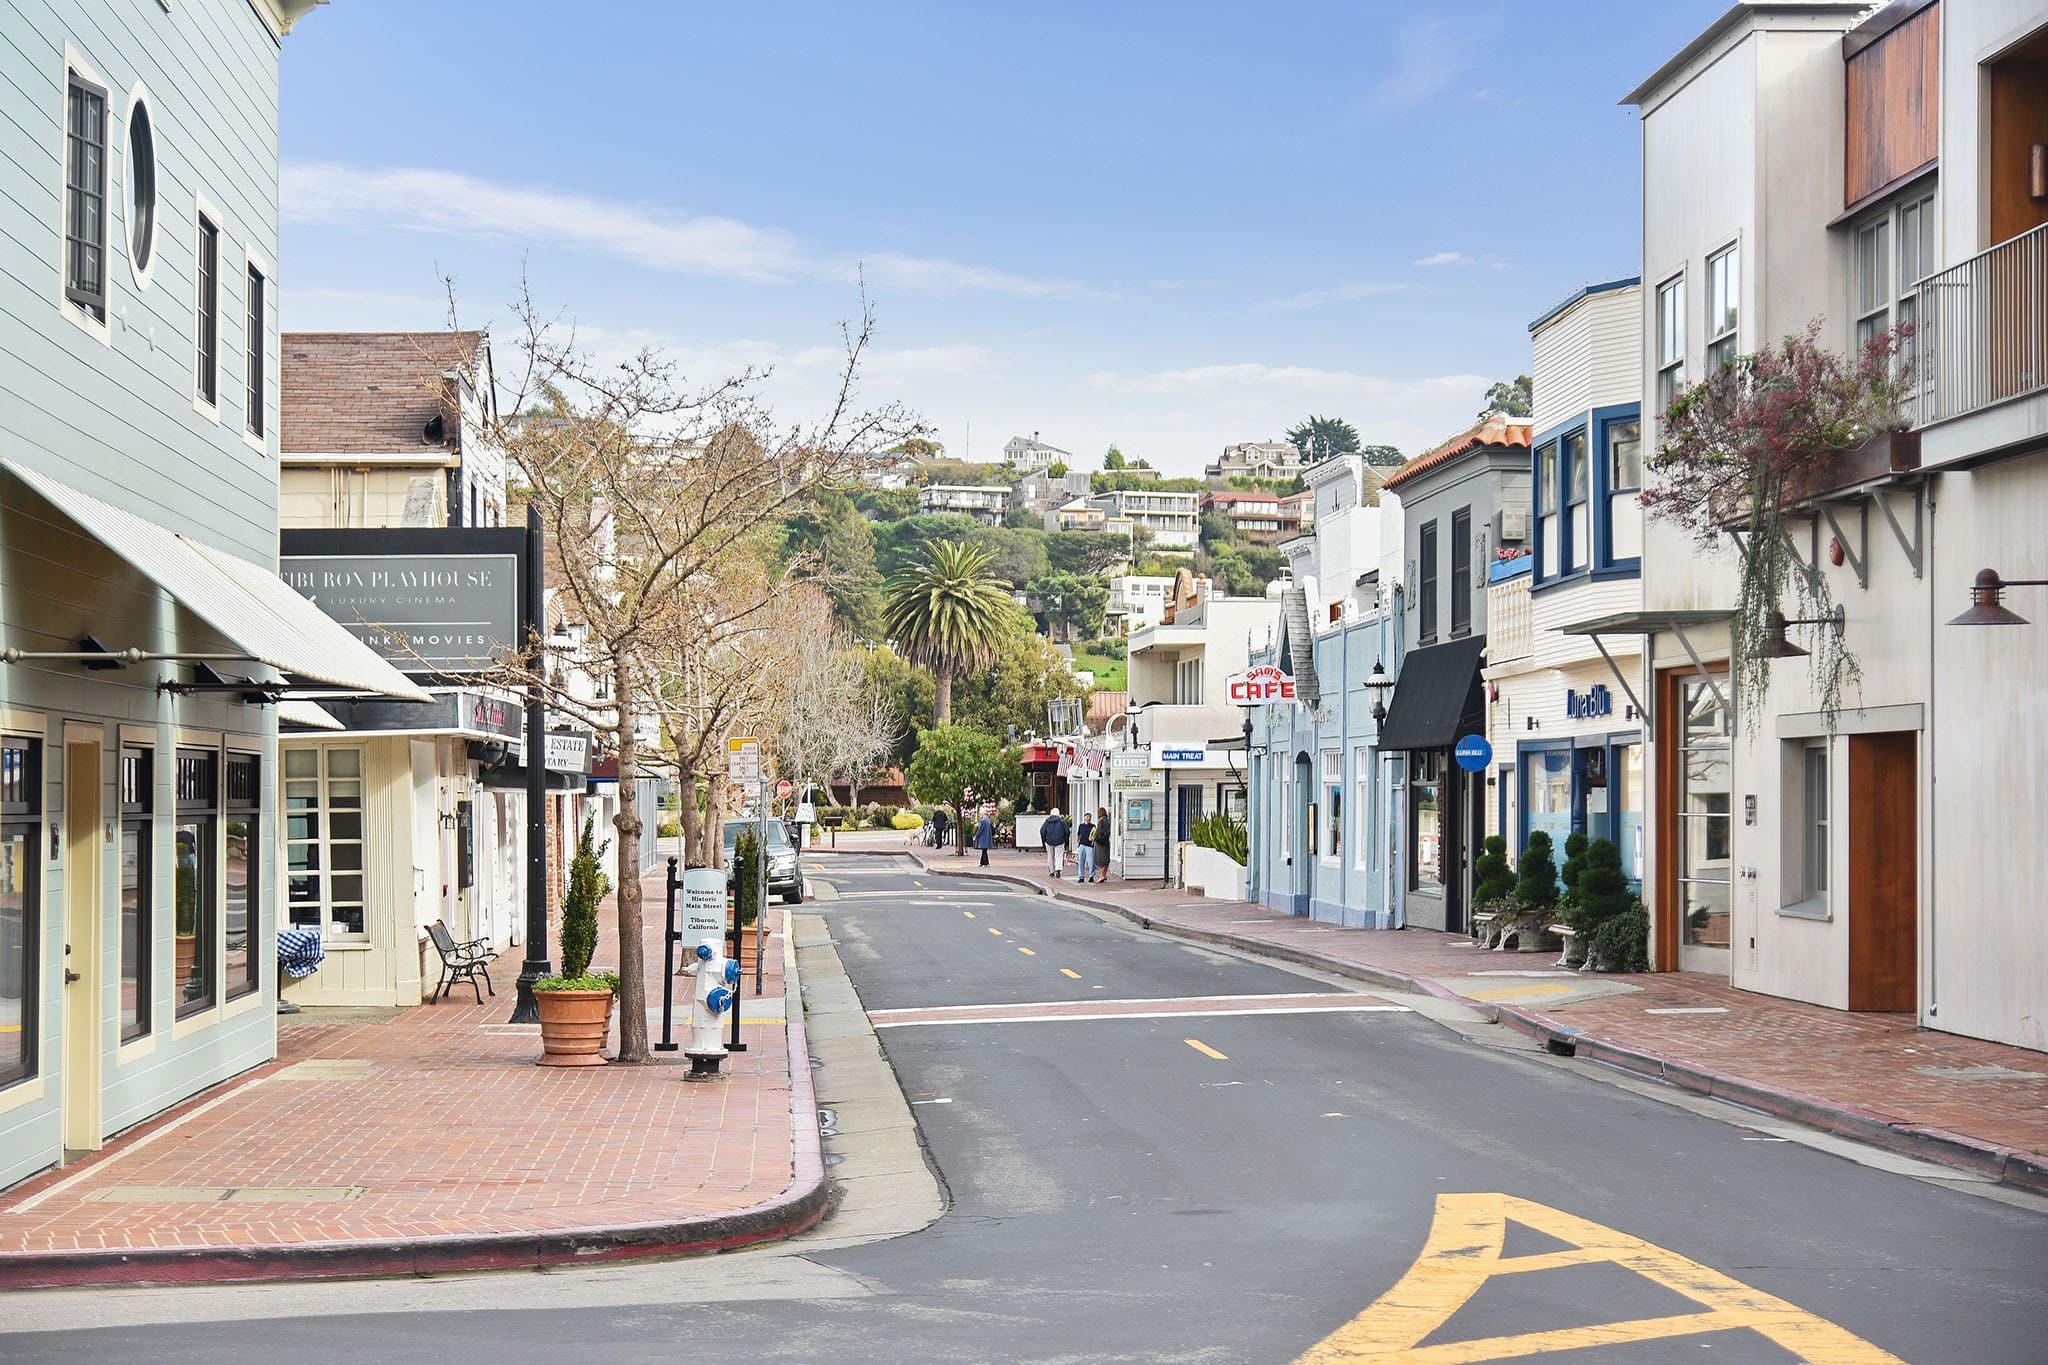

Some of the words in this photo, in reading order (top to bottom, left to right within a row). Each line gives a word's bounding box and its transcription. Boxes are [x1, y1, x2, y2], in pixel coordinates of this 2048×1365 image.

[372, 571, 492, 588] PLAYHOUSE
[330, 597, 386, 605] LUXURY
[413, 635, 485, 645] MOVIES
[1246, 667, 1283, 681] SAM'S
[1231, 682, 1295, 699] CAFE
[1567, 689, 1588, 719] Luna
[1590, 684, 1611, 717] Blu
[551, 738, 584, 752] ESTATE
[547, 757, 569, 768] TARY
[1163, 752, 1180, 760] MAIN
[1181, 752, 1202, 760] TREAT
